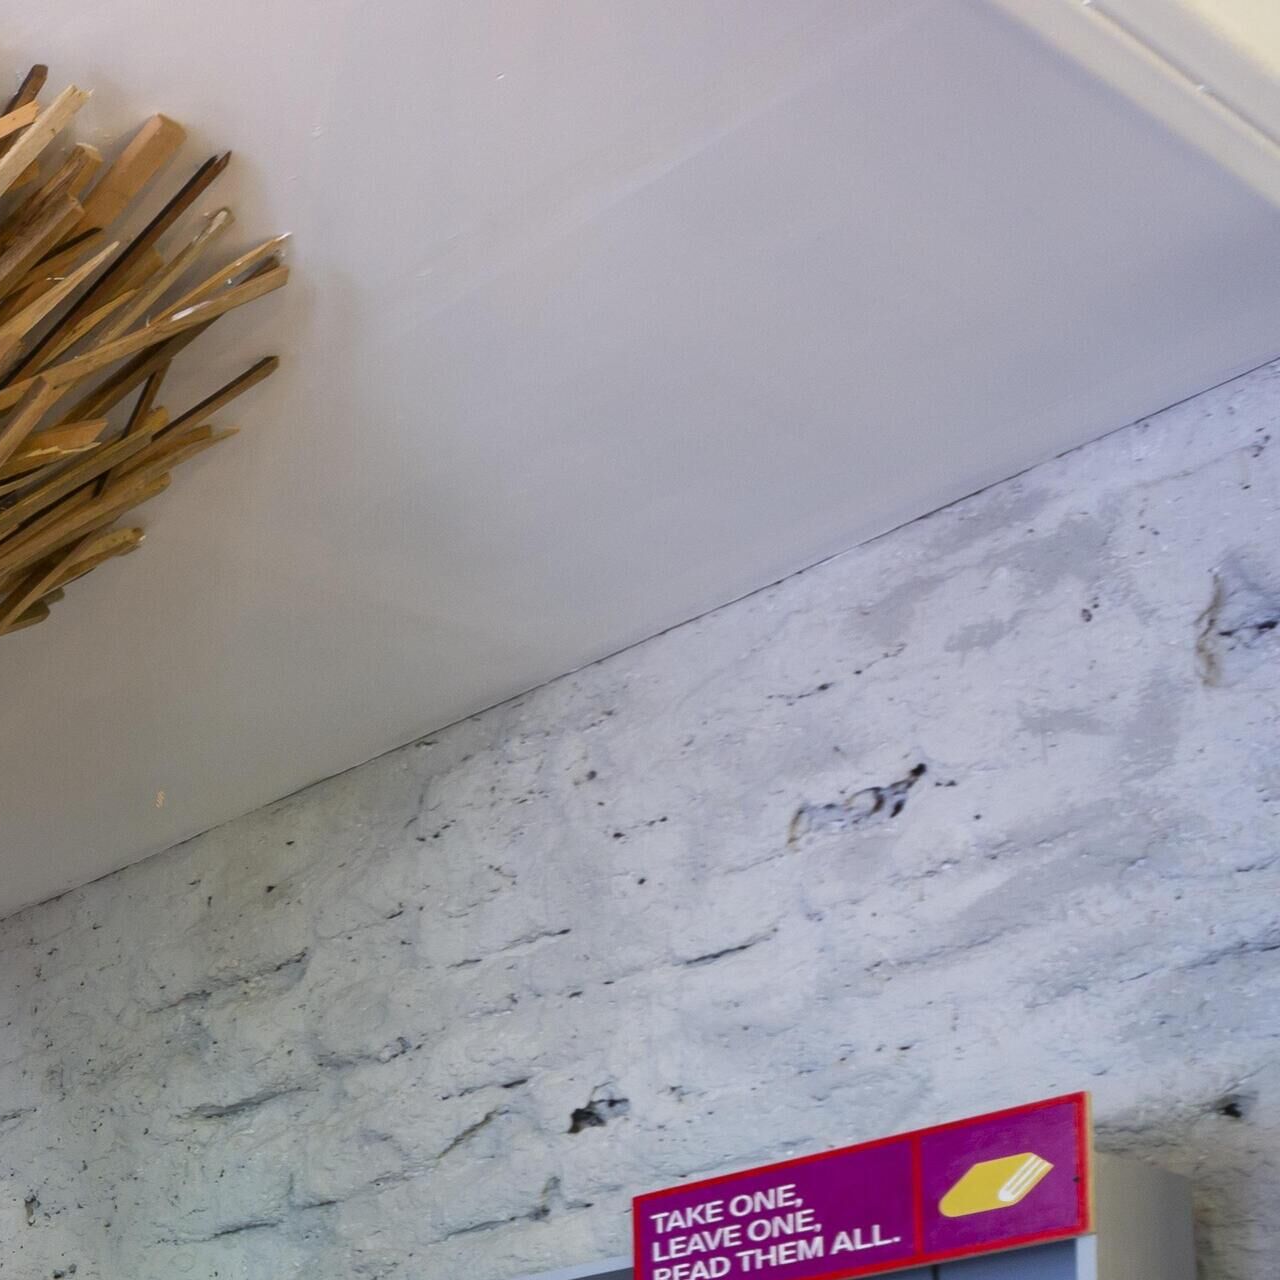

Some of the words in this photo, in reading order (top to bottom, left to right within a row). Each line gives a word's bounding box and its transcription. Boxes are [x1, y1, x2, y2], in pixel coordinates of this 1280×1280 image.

[651, 1201, 724, 1234] TAKE
[729, 1184, 804, 1217] ONE,
[651, 1230, 743, 1262] LEAVE
[747, 1210, 822, 1242] ONE,
[737, 1240, 825, 1273] THEM
[829, 1224, 901, 1256] ALL.
